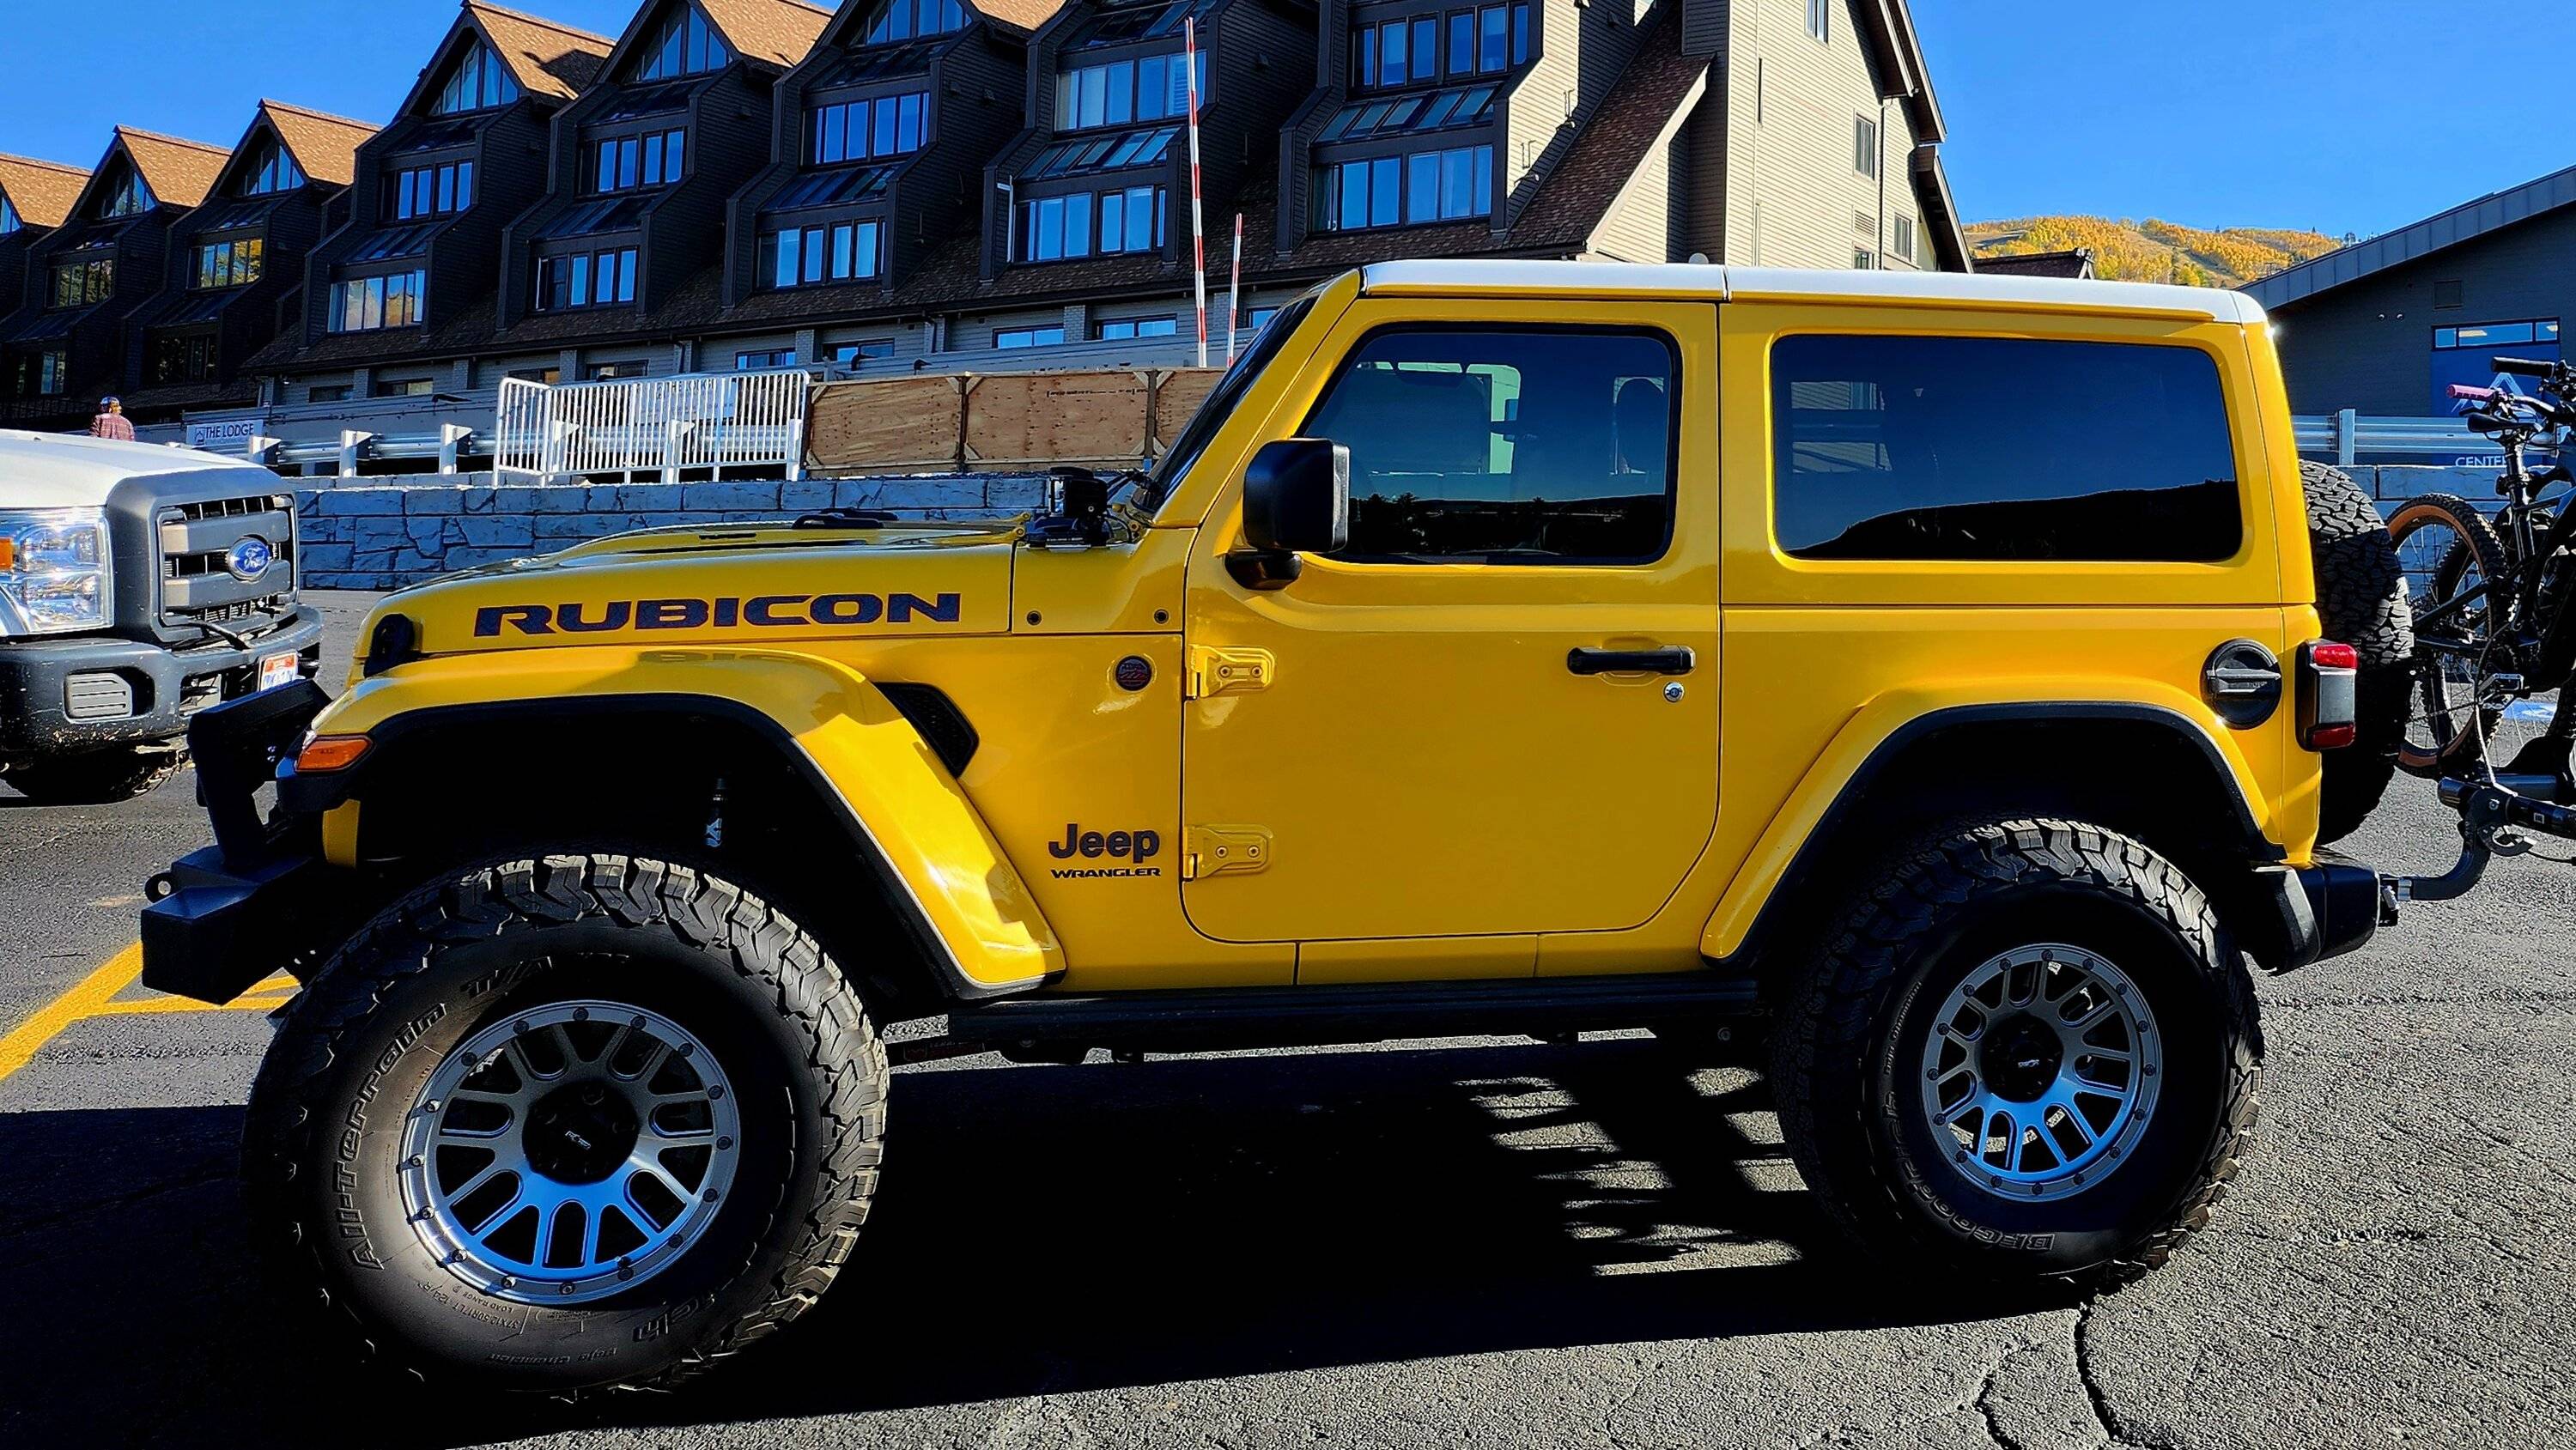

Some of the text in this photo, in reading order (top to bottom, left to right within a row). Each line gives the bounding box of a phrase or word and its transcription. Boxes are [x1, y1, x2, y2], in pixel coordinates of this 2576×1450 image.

[206, 423, 254, 439] THE LODGE
[473, 592, 961, 638] RUBICON
[1048, 823, 1159, 864] Jeep
[1051, 867, 1161, 879] WRANGLER
